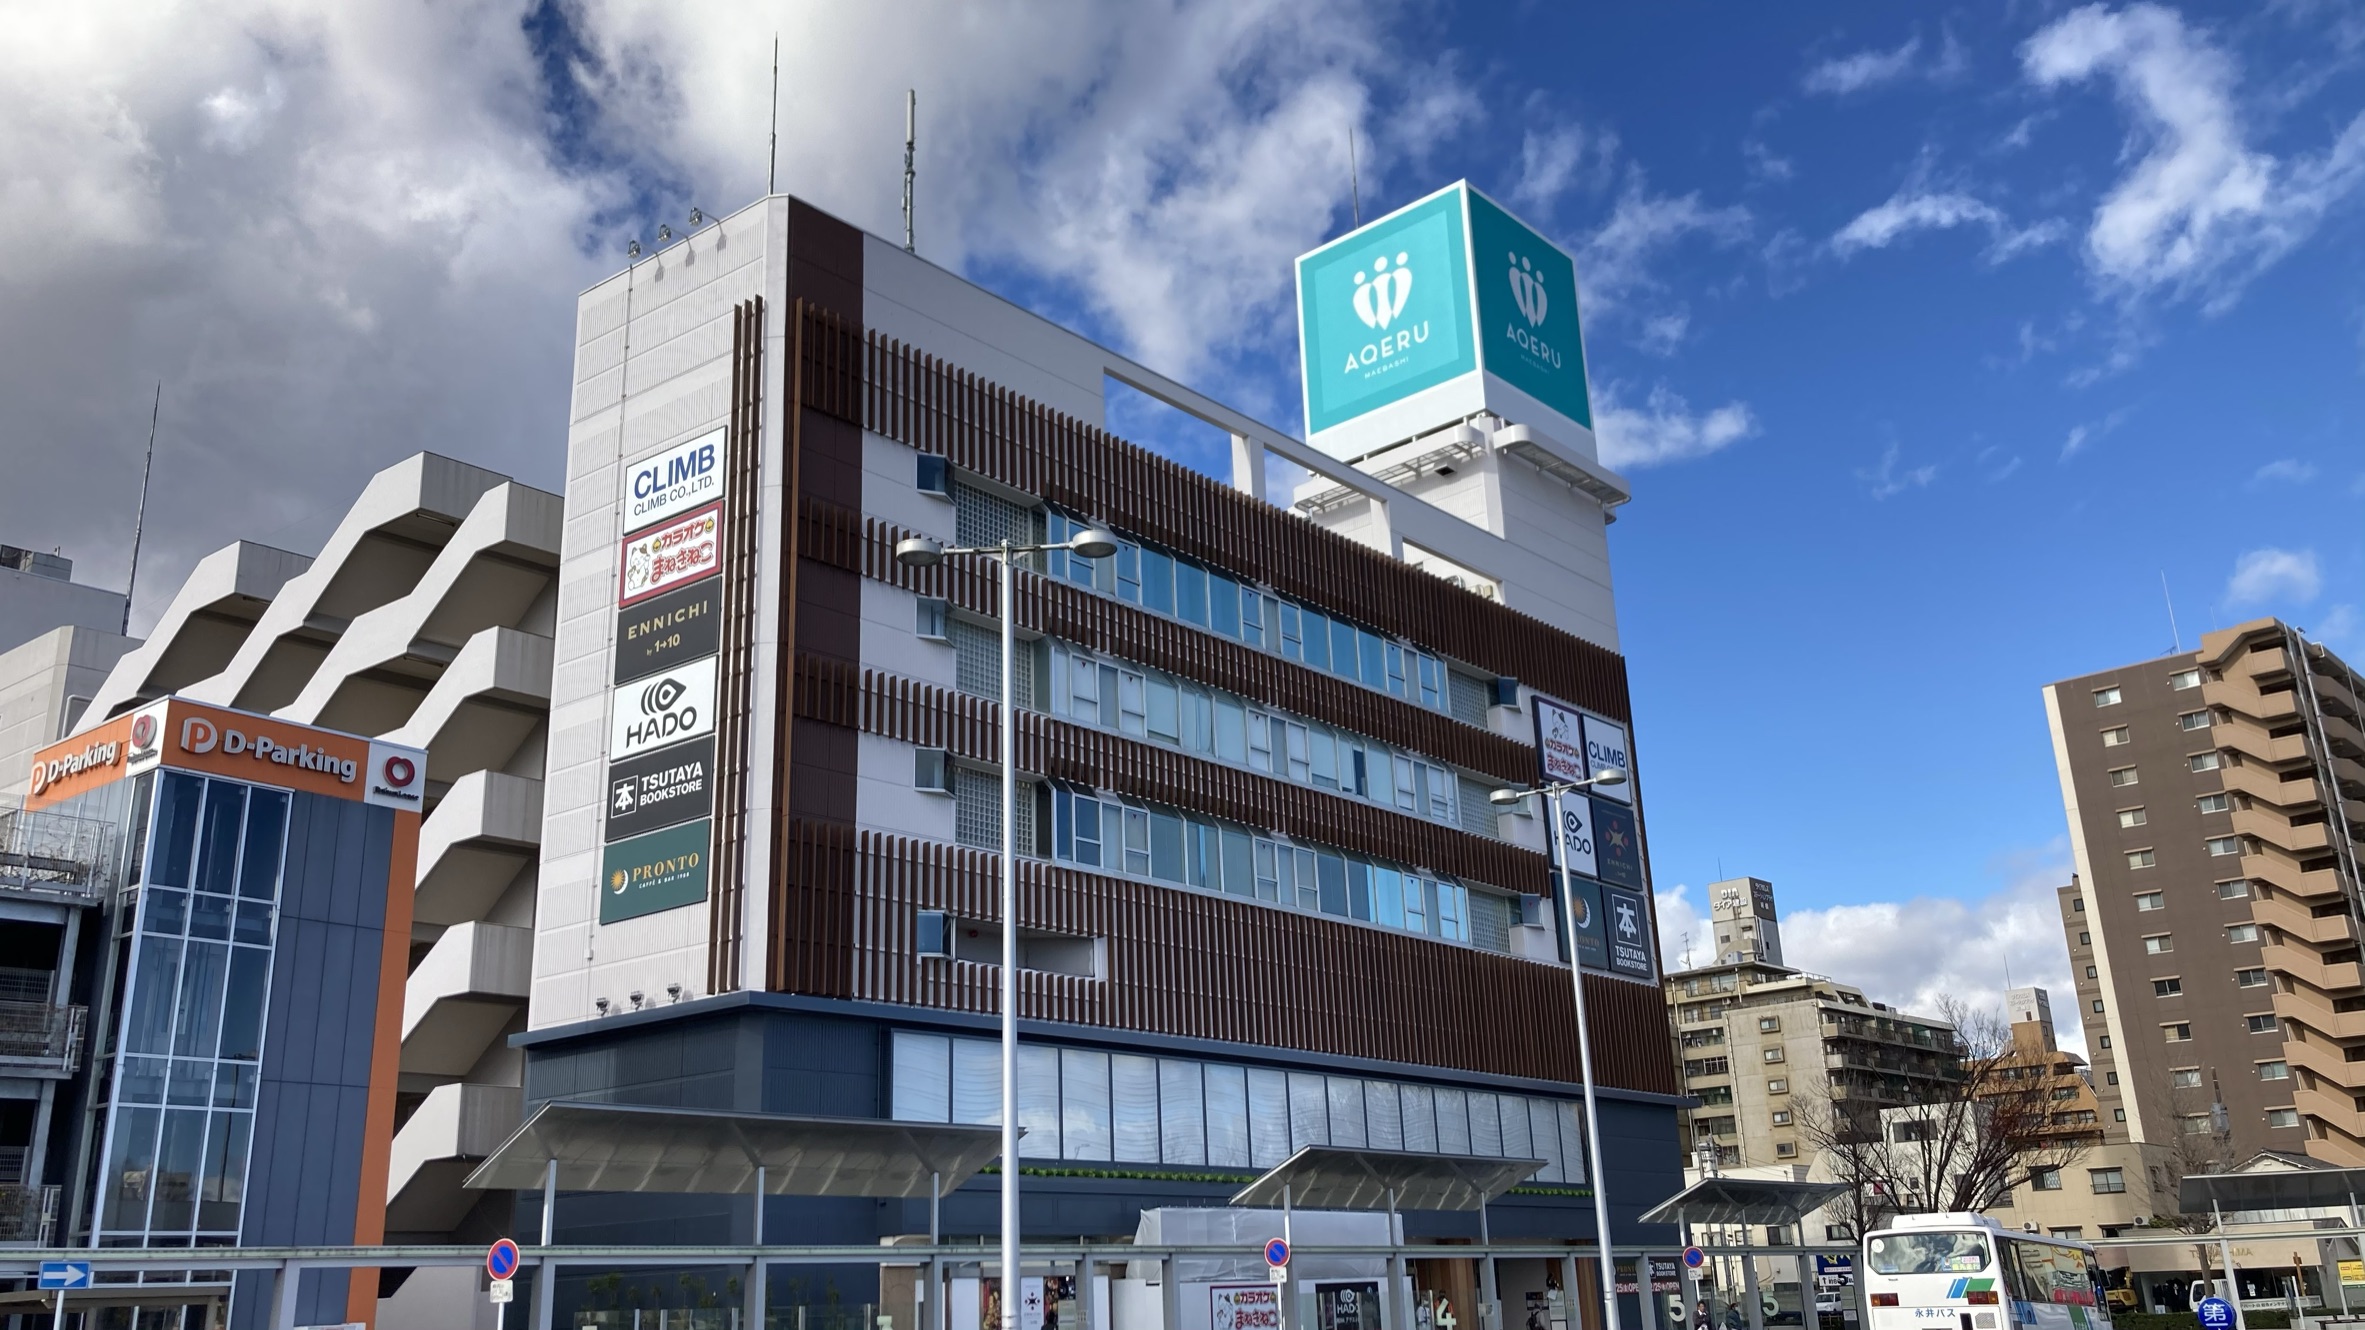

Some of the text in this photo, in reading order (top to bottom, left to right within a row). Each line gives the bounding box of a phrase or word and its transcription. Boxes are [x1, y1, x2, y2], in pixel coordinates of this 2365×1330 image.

[1344, 320, 1430, 375] AQERU
[1506, 322, 1561, 369] AQERU
[1364, 356, 1410, 379] MAEBASHI
[634, 444, 716, 499] CLIMB
[633, 493, 667, 516] CLIMB
[661, 518, 706, 549] カラオケ
[650, 540, 715, 585] まねきねこ
[627, 600, 708, 640] ENNICHI
[626, 706, 697, 749] HADO
[47, 740, 120, 784] D-Parking
[223, 729, 357, 783] D-Parking
[1588, 741, 1625, 768] CLIMB
[641, 761, 704, 792] TSUTAYA
[639, 779, 703, 806] BOOKSTORE
[632, 852, 699, 882] PRONTO
[1615, 945, 1647, 962] TSUTAYA
[1616, 957, 1648, 972] BOOKSTORE
[1656, 1262, 1675, 1270] TSUTAYA
[1240, 1291, 1270, 1305] カラオケ
[1668, 1294, 1686, 1322] 5
[1762, 1289, 1779, 1317] 5
[1235, 1308, 1277, 1330] まねきねこ
[1436, 1298, 1457, 1330] 4
[1914, 1307, 1956, 1319] 永井バス
